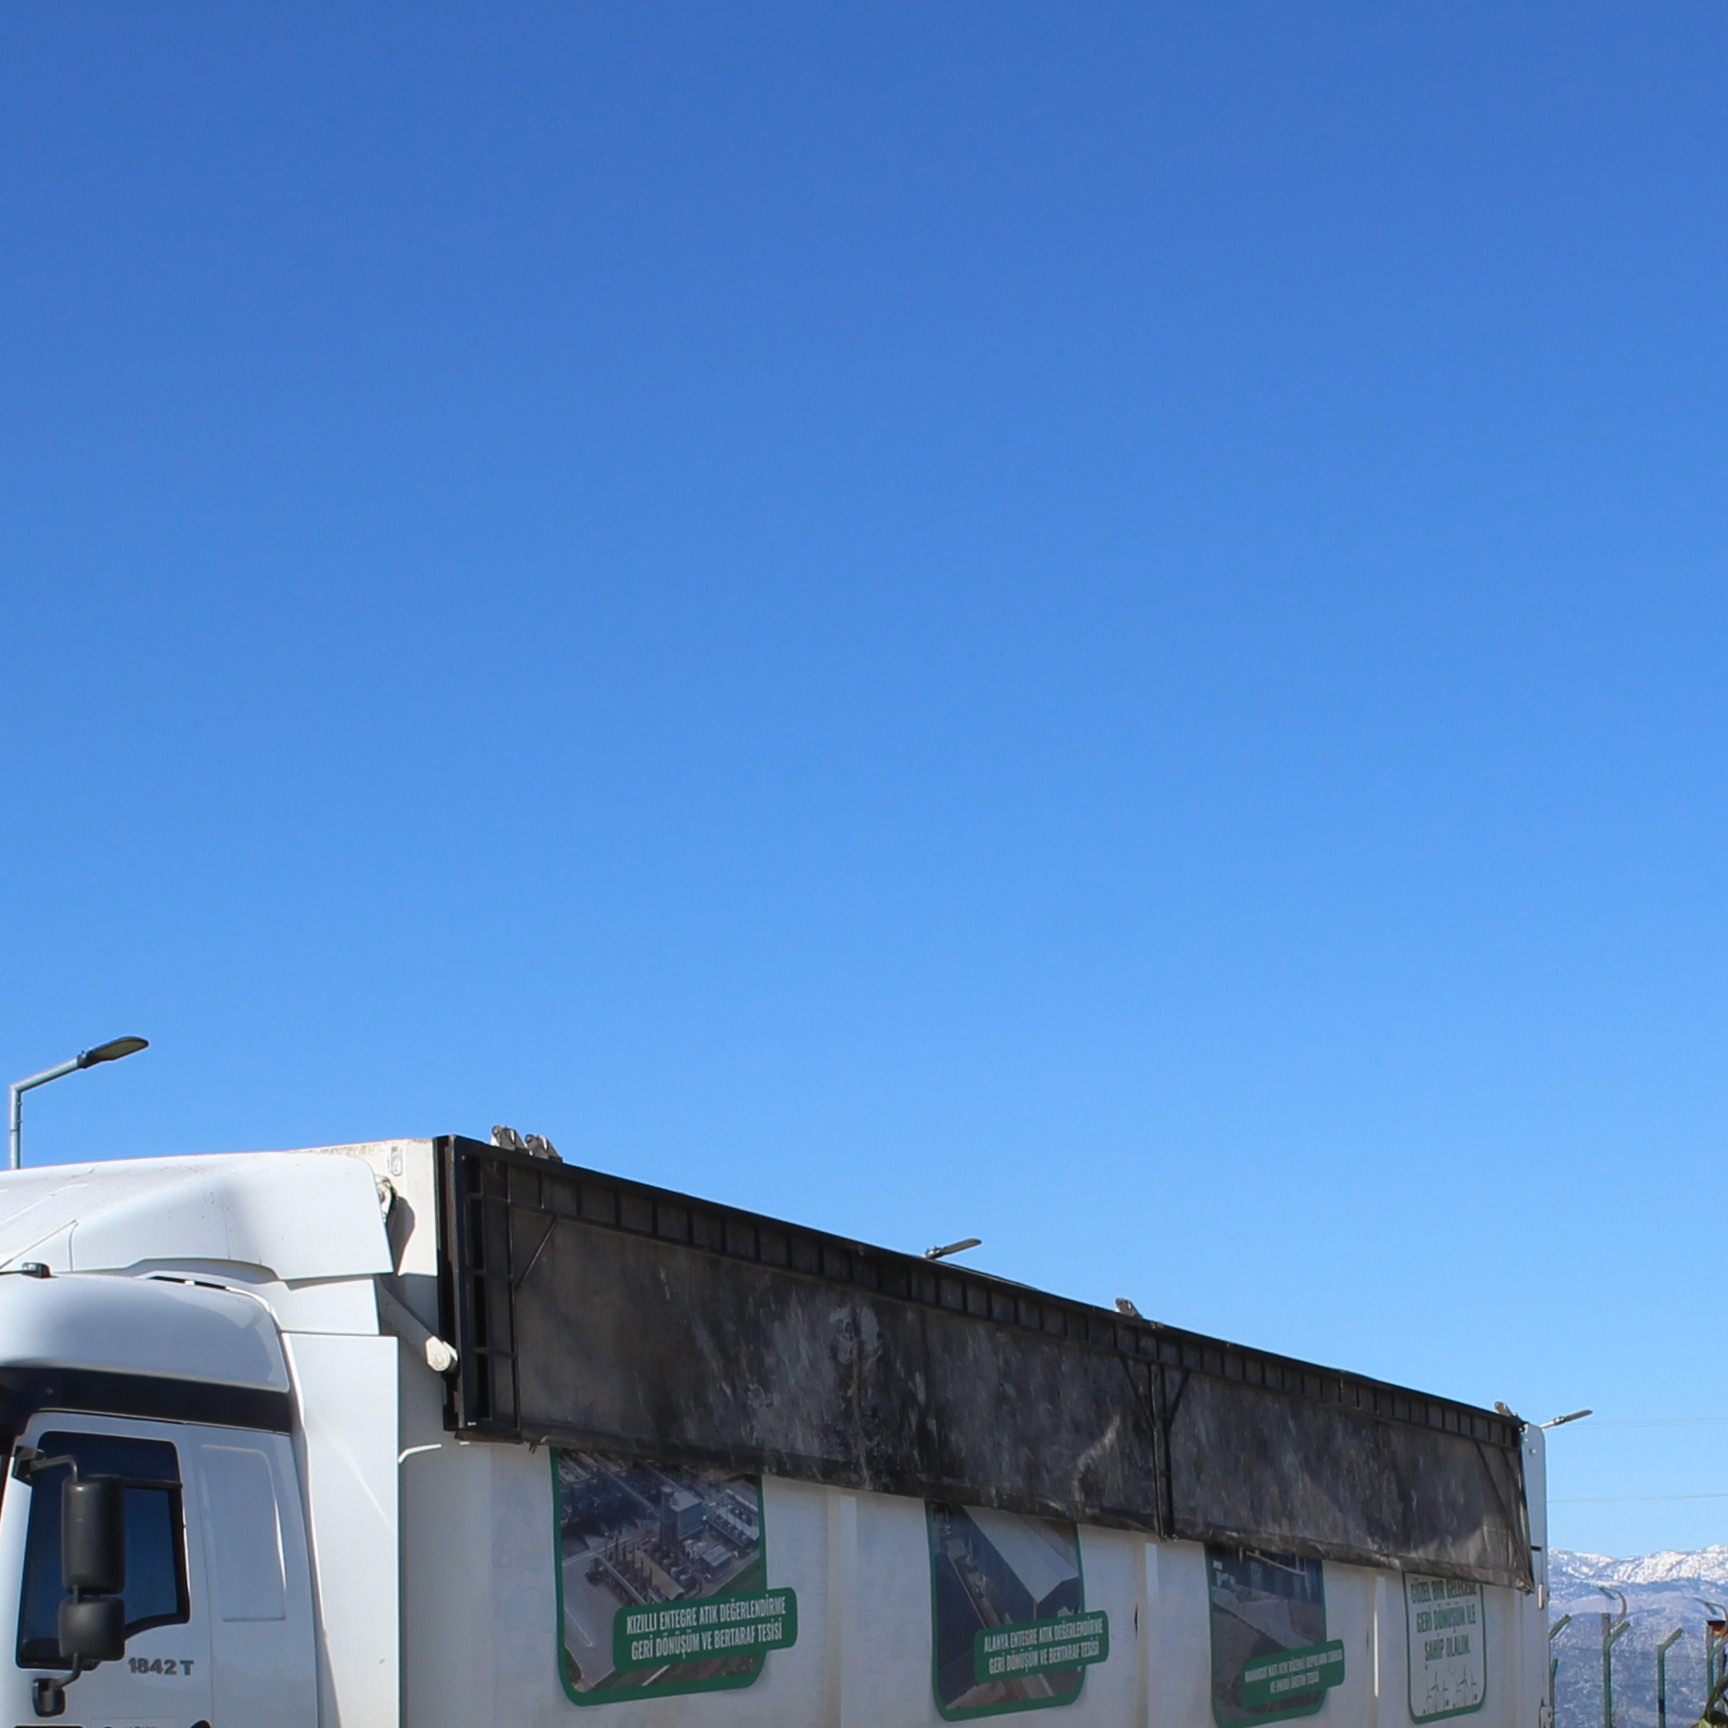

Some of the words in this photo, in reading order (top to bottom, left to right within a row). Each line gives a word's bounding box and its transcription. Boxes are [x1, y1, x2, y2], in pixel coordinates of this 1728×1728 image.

[626, 1613, 658, 1635] KIZILLI
[659, 1606, 698, 1631] ENTEGRE
[699, 1604, 719, 1626] ATIK
[719, 1593, 787, 1623] DEĞERLENDİRME
[631, 1634, 654, 1661] GERİ
[655, 1629, 700, 1659] DÖNÜŞÜM
[701, 1631, 713, 1651] VE
[713, 1625, 756, 1649] BERTARAF
[757, 1617, 783, 1643] TESİSİ
[1010, 1628, 1038, 1649] ENTEGRE
[1038, 1625, 1053, 1644] ATIK
[128, 1657, 177, 1676] 1842
[179, 1659, 194, 1676] T
[989, 1651, 1006, 1674] GERİ
[1039, 1648, 1049, 1666] VE
